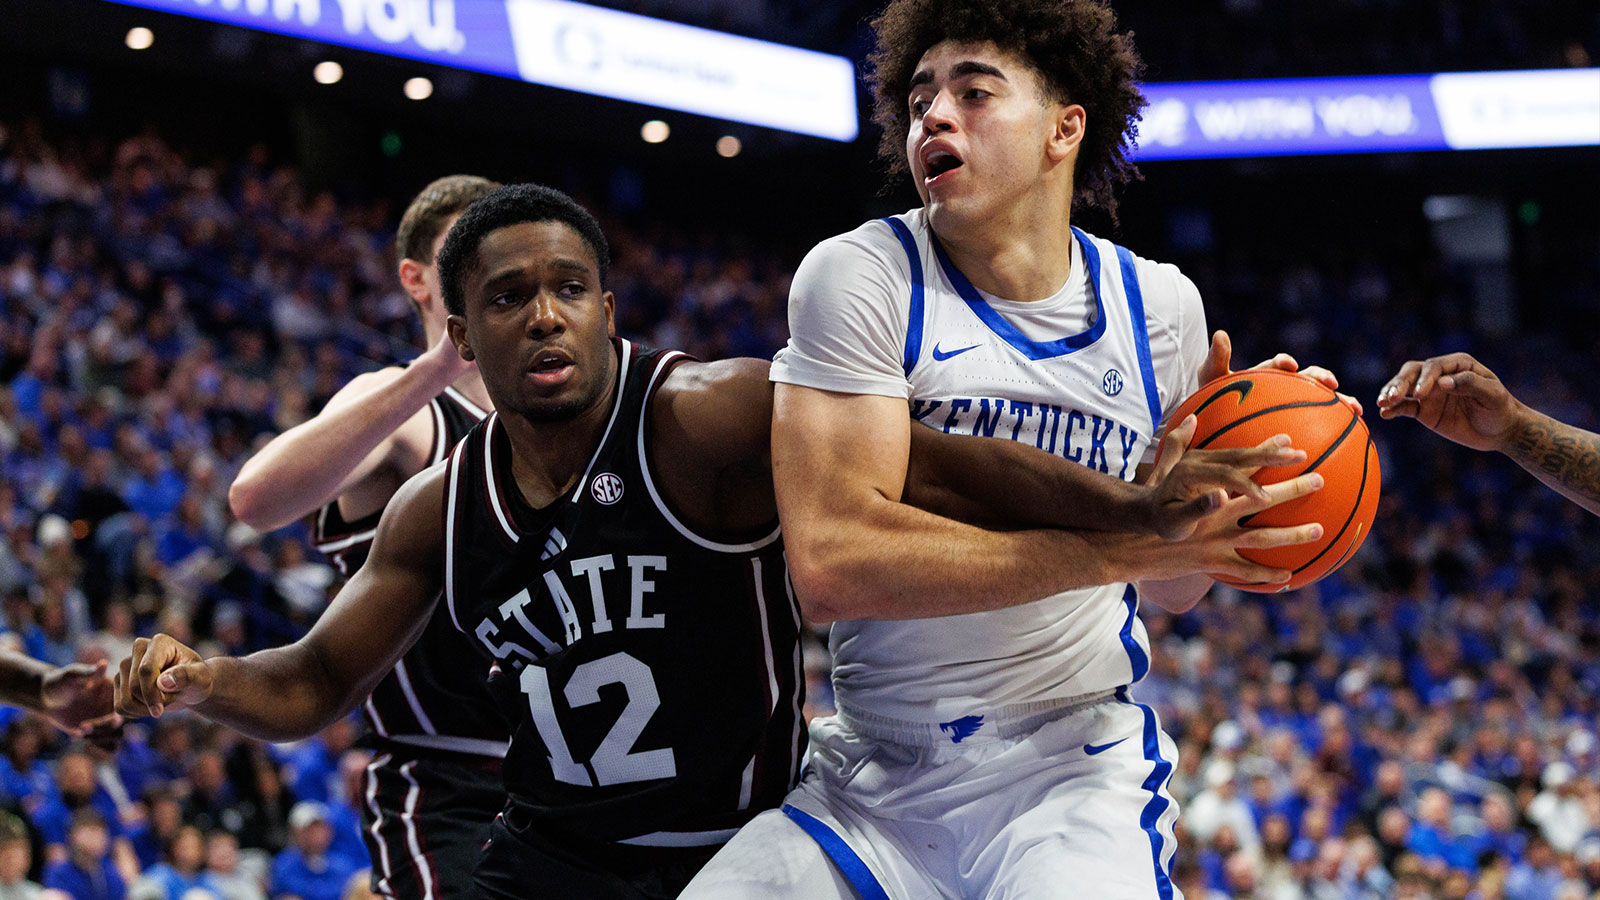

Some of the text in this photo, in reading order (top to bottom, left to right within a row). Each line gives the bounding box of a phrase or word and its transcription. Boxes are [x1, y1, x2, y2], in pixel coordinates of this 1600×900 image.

[1103, 370, 1123, 396] SEC
[594, 475, 622, 502] SEC
[475, 553, 668, 669] STATE
[519, 651, 677, 787] 12
